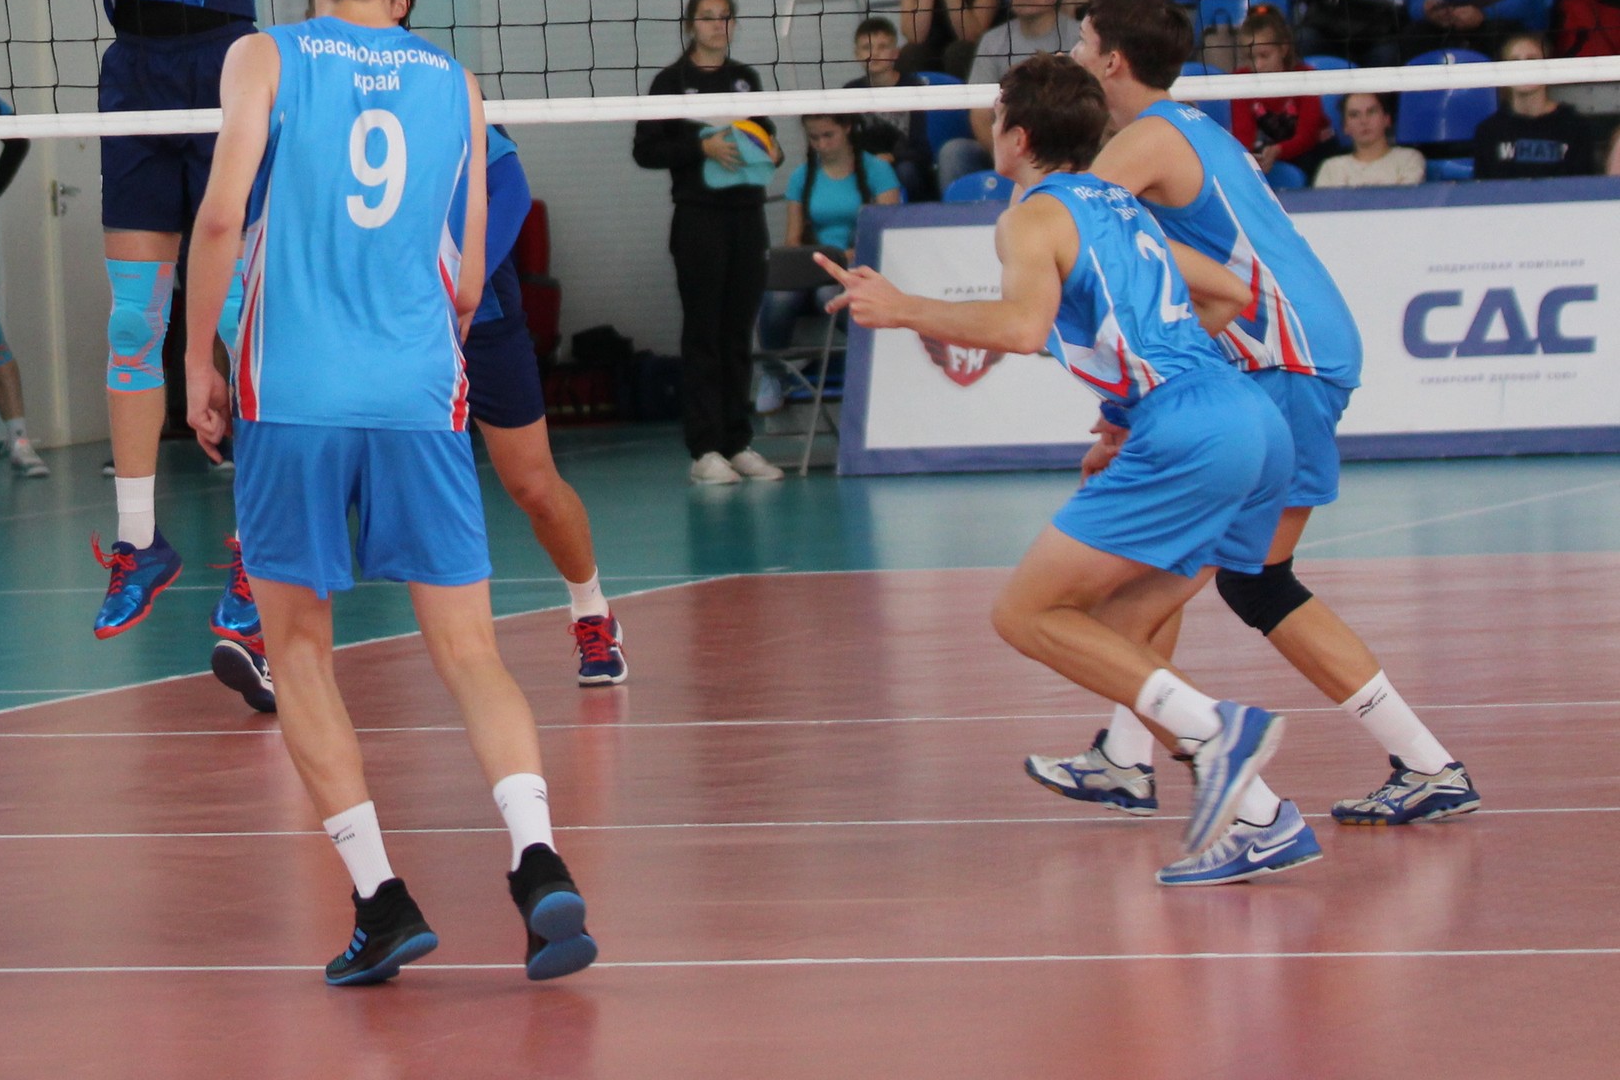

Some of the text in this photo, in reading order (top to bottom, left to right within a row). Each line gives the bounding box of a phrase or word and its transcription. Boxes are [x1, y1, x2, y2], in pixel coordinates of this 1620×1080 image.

[297, 34, 450, 71] Краснодарский
[353, 69, 400, 95] край
[346, 108, 407, 230] 9
[1135, 229, 1193, 324] 2
